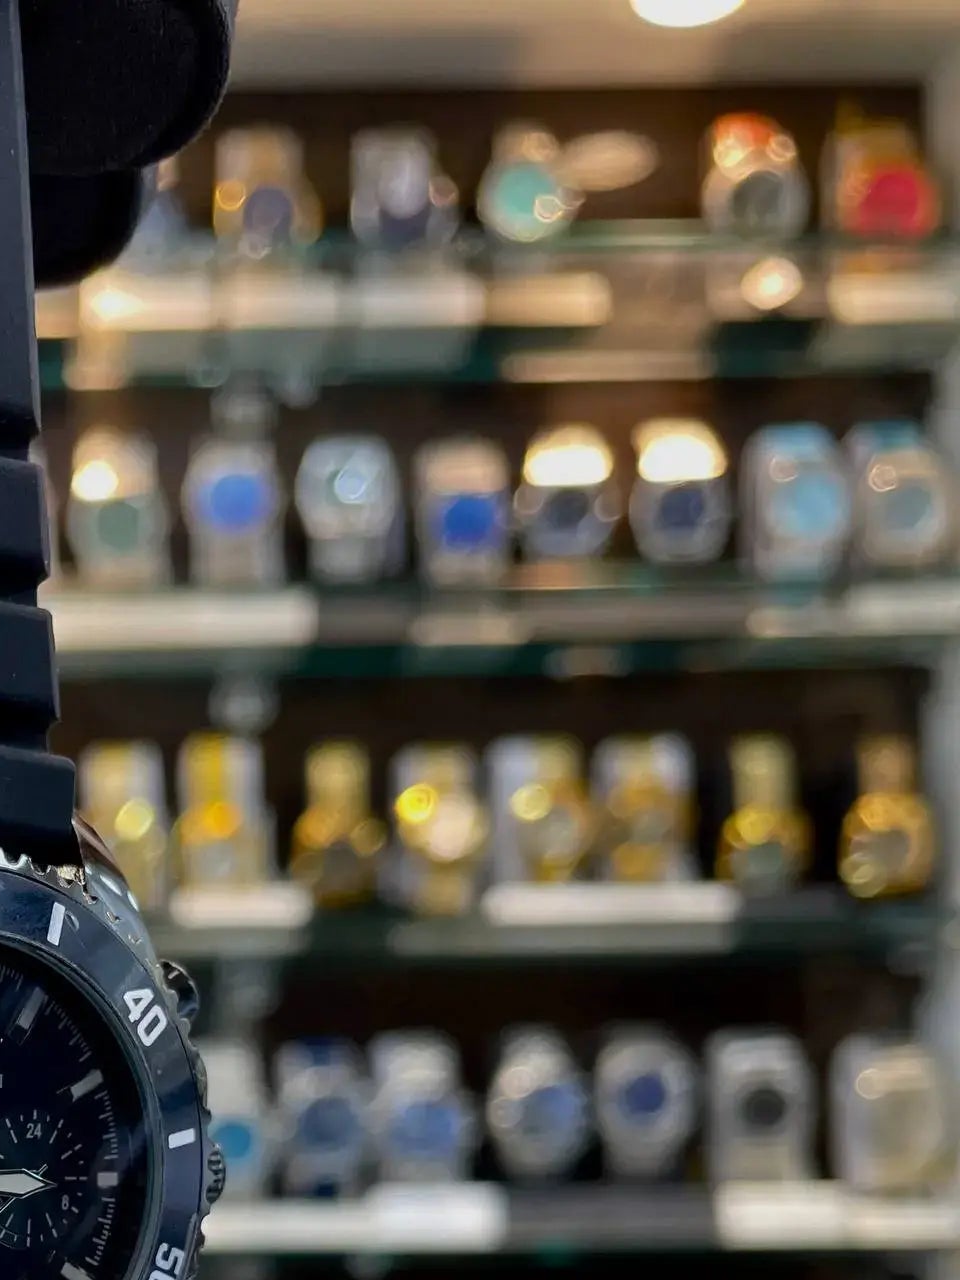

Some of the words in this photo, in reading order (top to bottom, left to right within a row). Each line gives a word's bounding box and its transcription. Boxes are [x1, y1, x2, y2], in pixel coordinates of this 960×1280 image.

[123, 988, 166, 1047] 40
[26, 1123, 41, 1139] 24
[61, 1195, 70, 1210] 8
